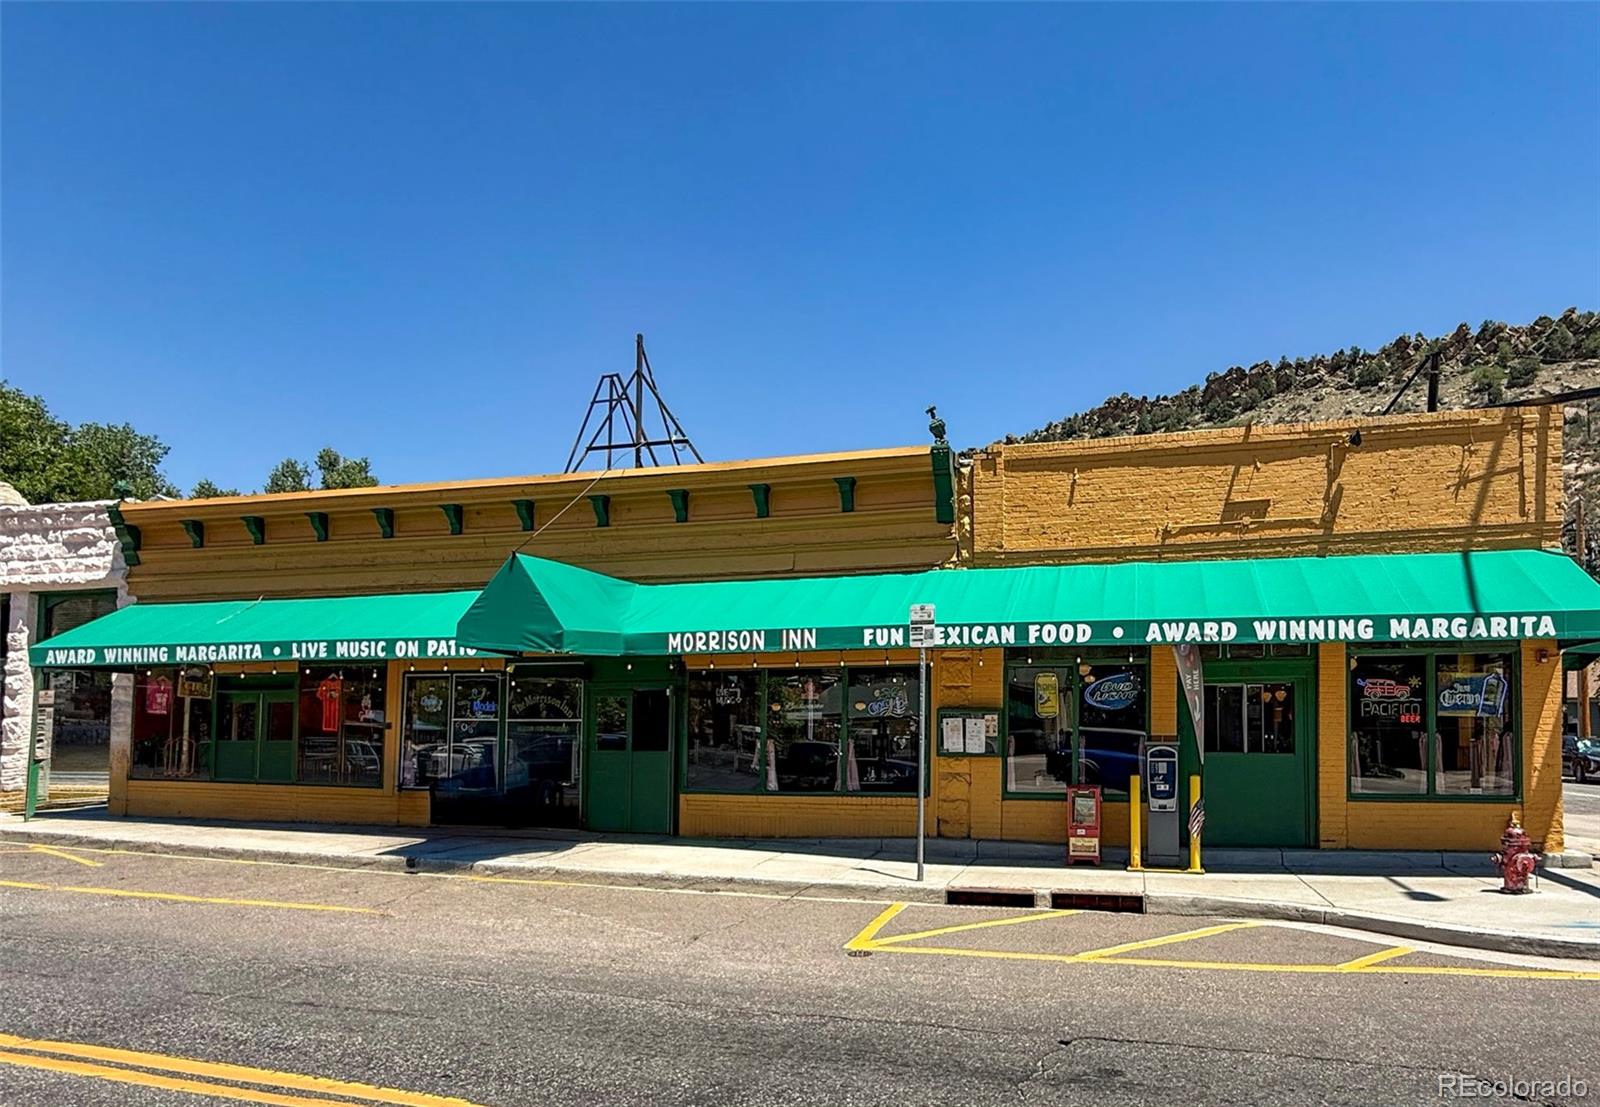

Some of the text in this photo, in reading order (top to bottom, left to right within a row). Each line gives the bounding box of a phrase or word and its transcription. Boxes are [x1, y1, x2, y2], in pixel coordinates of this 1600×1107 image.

[863, 627, 904, 646] FUN
[934, 625, 1015, 646] EXICAN
[1028, 623, 1093, 644] FOOD
[1145, 620, 1238, 643] AWARD
[1253, 617, 1375, 642] WINNING
[1389, 614, 1557, 641] MARGARITA
[666, 628, 817, 654] MORRISON INN
[45, 648, 96, 665] AWARD
[103, 646, 168, 664] WINNING
[176, 643, 262, 661] MARGARITA
[291, 642, 327, 659] LIVE
[336, 640, 386, 658] MUSIC
[395, 640, 419, 658] ON
[1100, 681, 1133, 692] BUD
[1093, 690, 1138, 701] LIGHT
[1361, 701, 1421, 717] PACIFICO
[1400, 714, 1421, 724] BEER
